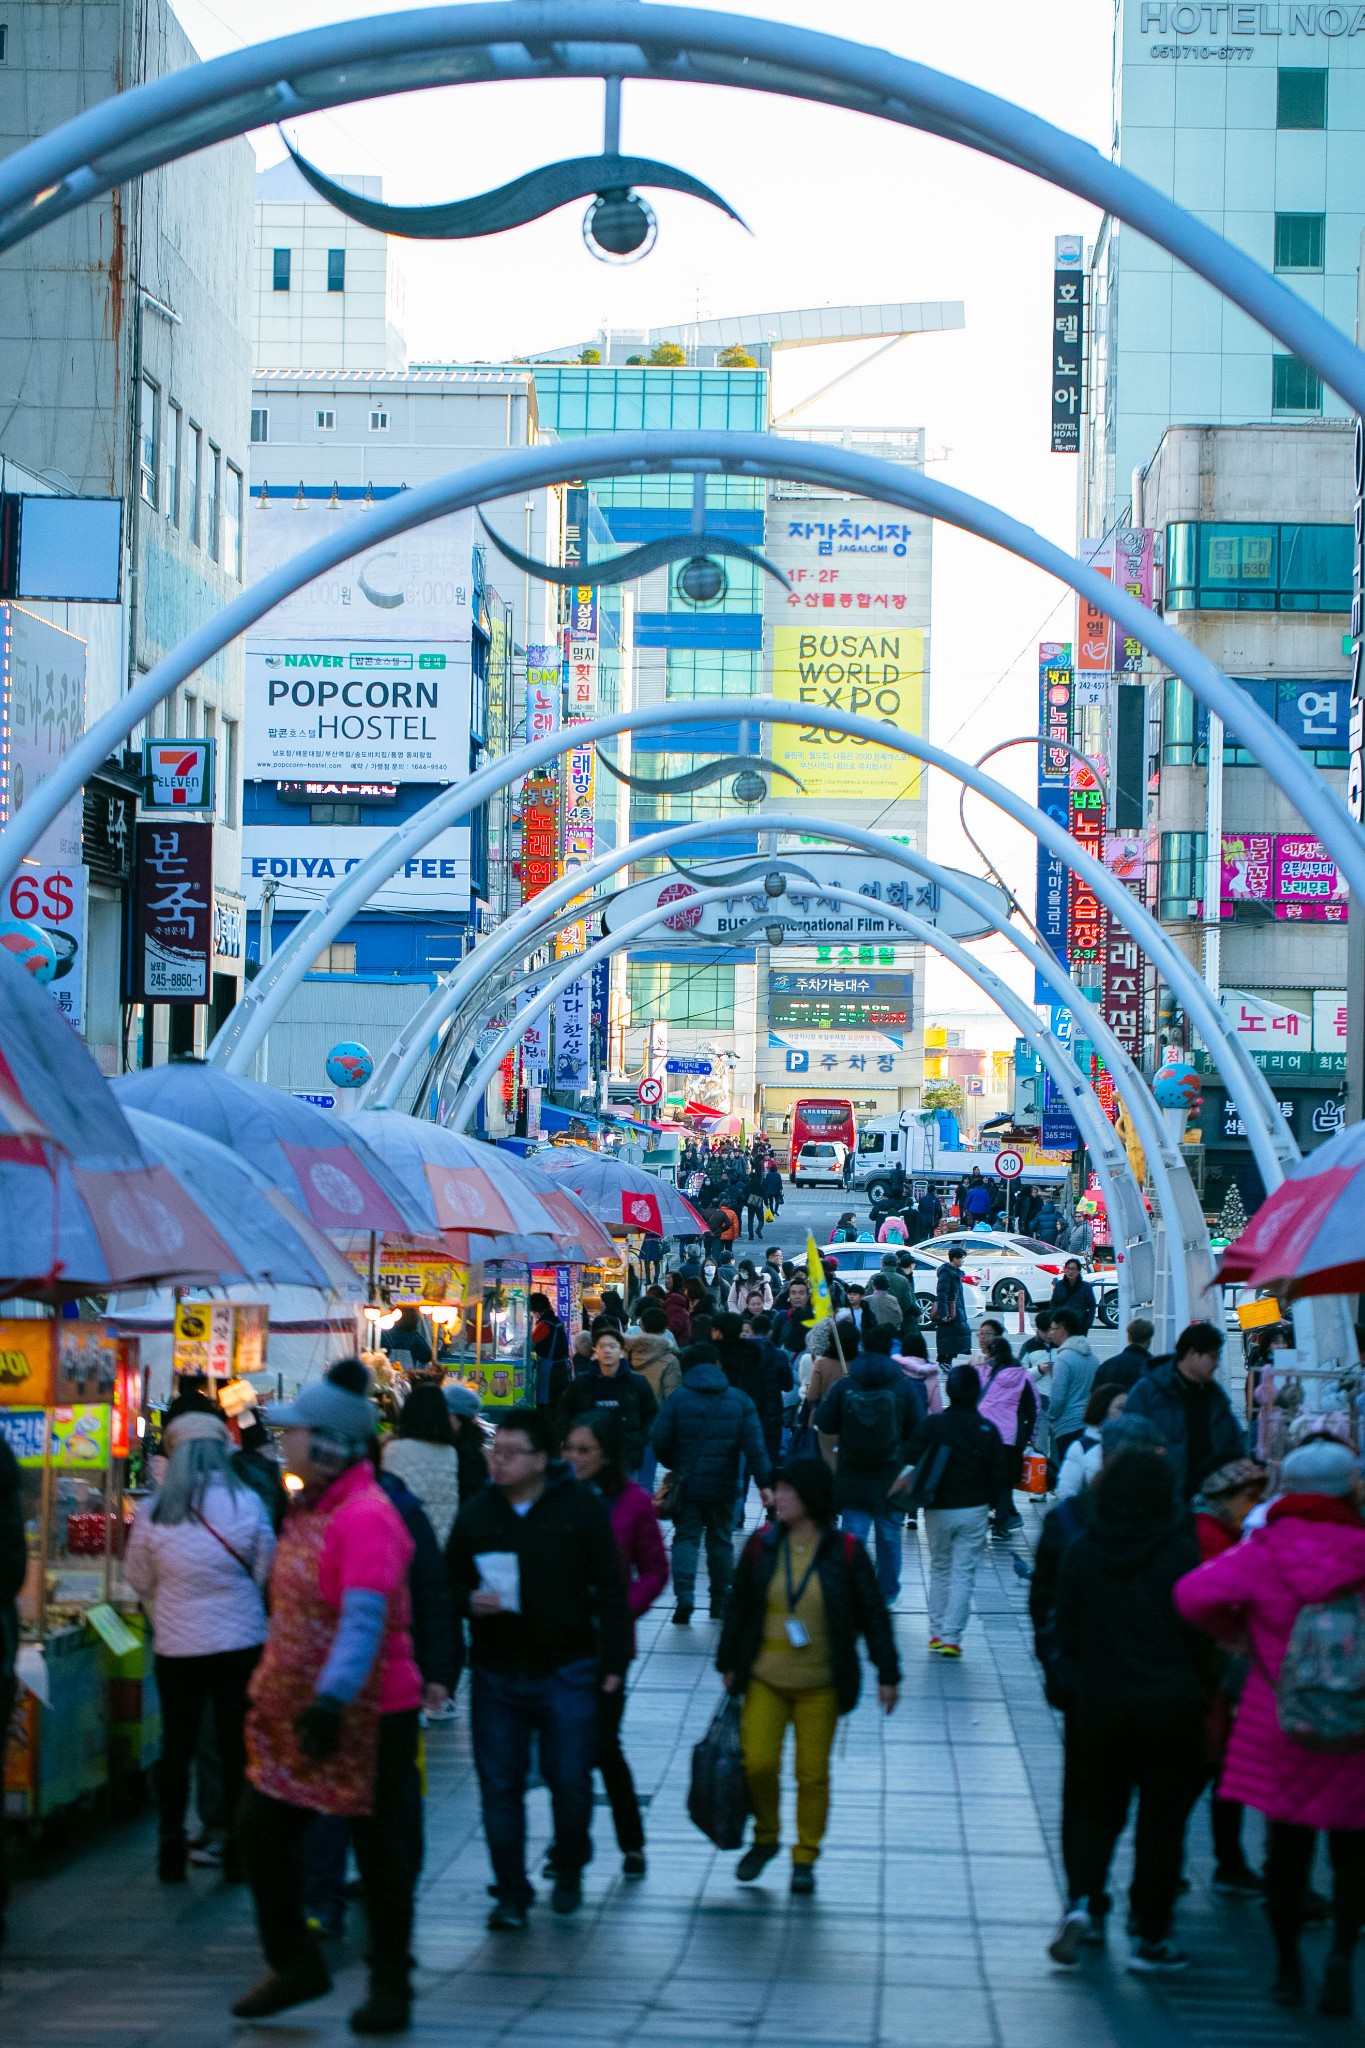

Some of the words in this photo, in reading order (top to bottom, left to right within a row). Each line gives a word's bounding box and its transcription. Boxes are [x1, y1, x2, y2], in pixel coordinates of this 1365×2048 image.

[1140, 2, 1282, 35] HOTEL
[788, 519, 911, 557] 자갈치시장
[838, 544, 887, 552] JAGALCHI
[787, 592, 907, 609] 수산물종합시장
[573, 647, 595, 661] 명지
[799, 633, 900, 659] BUSAN
[285, 654, 343, 668] NAVER
[423, 657, 442, 668] 검색
[1124, 660, 1142, 671] 4F
[528, 667, 559, 684] DM
[799, 662, 900, 685] WORLD
[268, 680, 438, 708] POPCORN
[1089, 694, 1098, 703] 5F
[318, 715, 437, 740] HOSTEL
[1049, 706, 1068, 766] 노래방
[1073, 791, 1101, 809] 남포
[569, 807, 591, 819] 4층
[252, 858, 336, 879] EDIYA
[345, 858, 456, 879] CFEE
[1248, 838, 1269, 890] 불꽃
[144, 832, 208, 939] 본죽
[1253, 890, 1267, 898] 3F
[1281, 880, 1331, 896] 노래무료
[9, 870, 74, 925] 6$
[1046, 861, 1062, 935] 새마을금고
[857, 917, 884, 931] Film
[150, 961, 167, 972] 남포점
[796, 978, 870, 993] 주차가능대수
[790, 1052, 804, 1070] P
[820, 1053, 896, 1073] 주차장
[1254, 1055, 1301, 1069] 테리어
[1044, 1131, 1058, 1139] 365
[1058, 1131, 1072, 1140] 코너
[1002, 1159, 1016, 1171] 30
